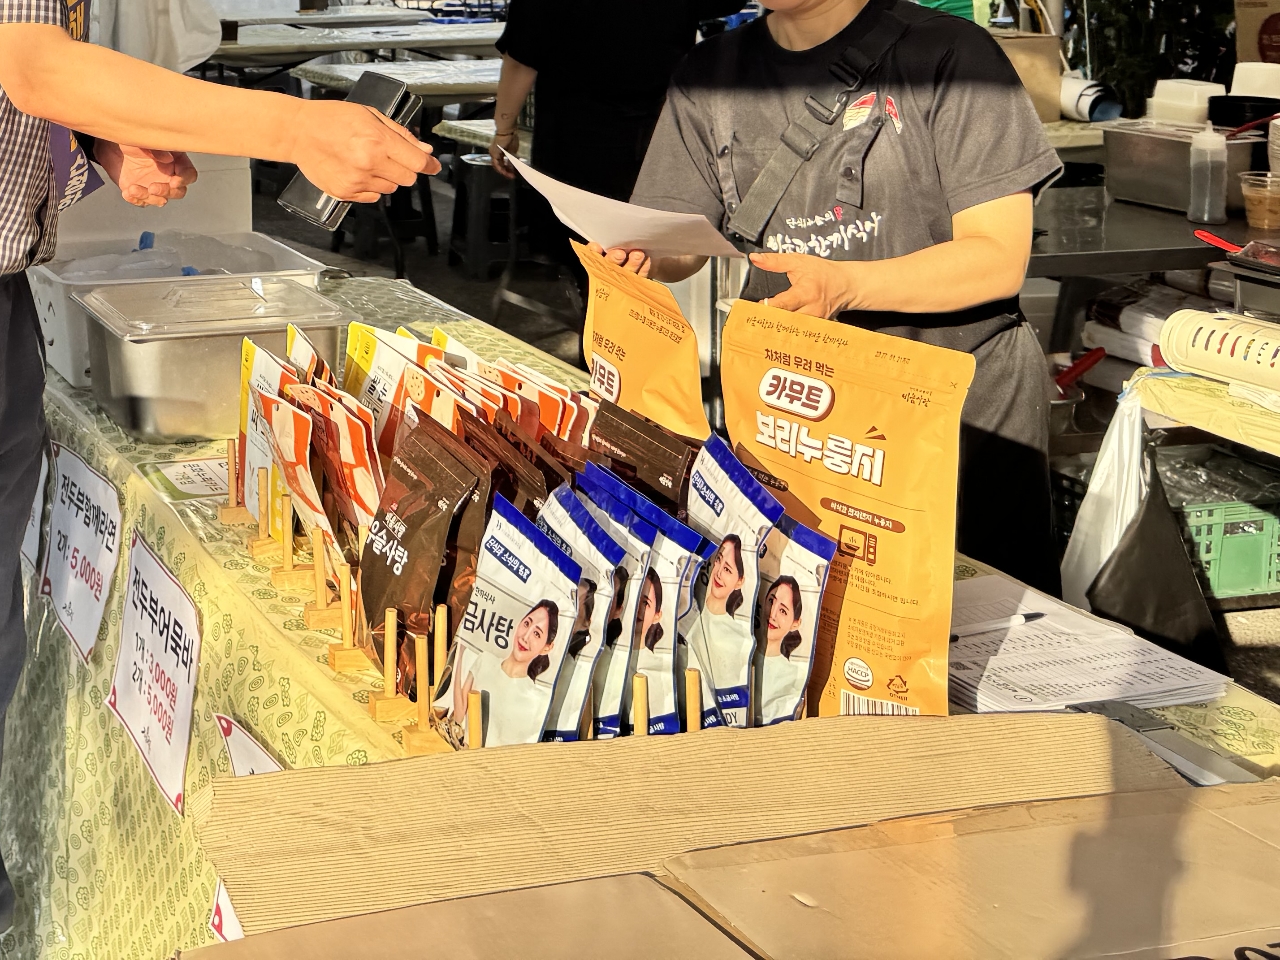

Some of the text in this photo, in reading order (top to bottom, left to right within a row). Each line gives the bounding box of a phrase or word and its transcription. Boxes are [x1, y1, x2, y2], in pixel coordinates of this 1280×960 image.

[764, 348, 835, 378] 차처럼 우려 먹는
[765, 374, 824, 411] 카무트
[755, 409, 886, 487] 보리누룽지
[60, 473, 117, 554] 전두부함께라면
[70, 546, 103, 602] 5,000원
[132, 565, 194, 684] 전두부어묵바
[148, 652, 178, 713] 3,000원
[146, 683, 174, 746] 5,000원
